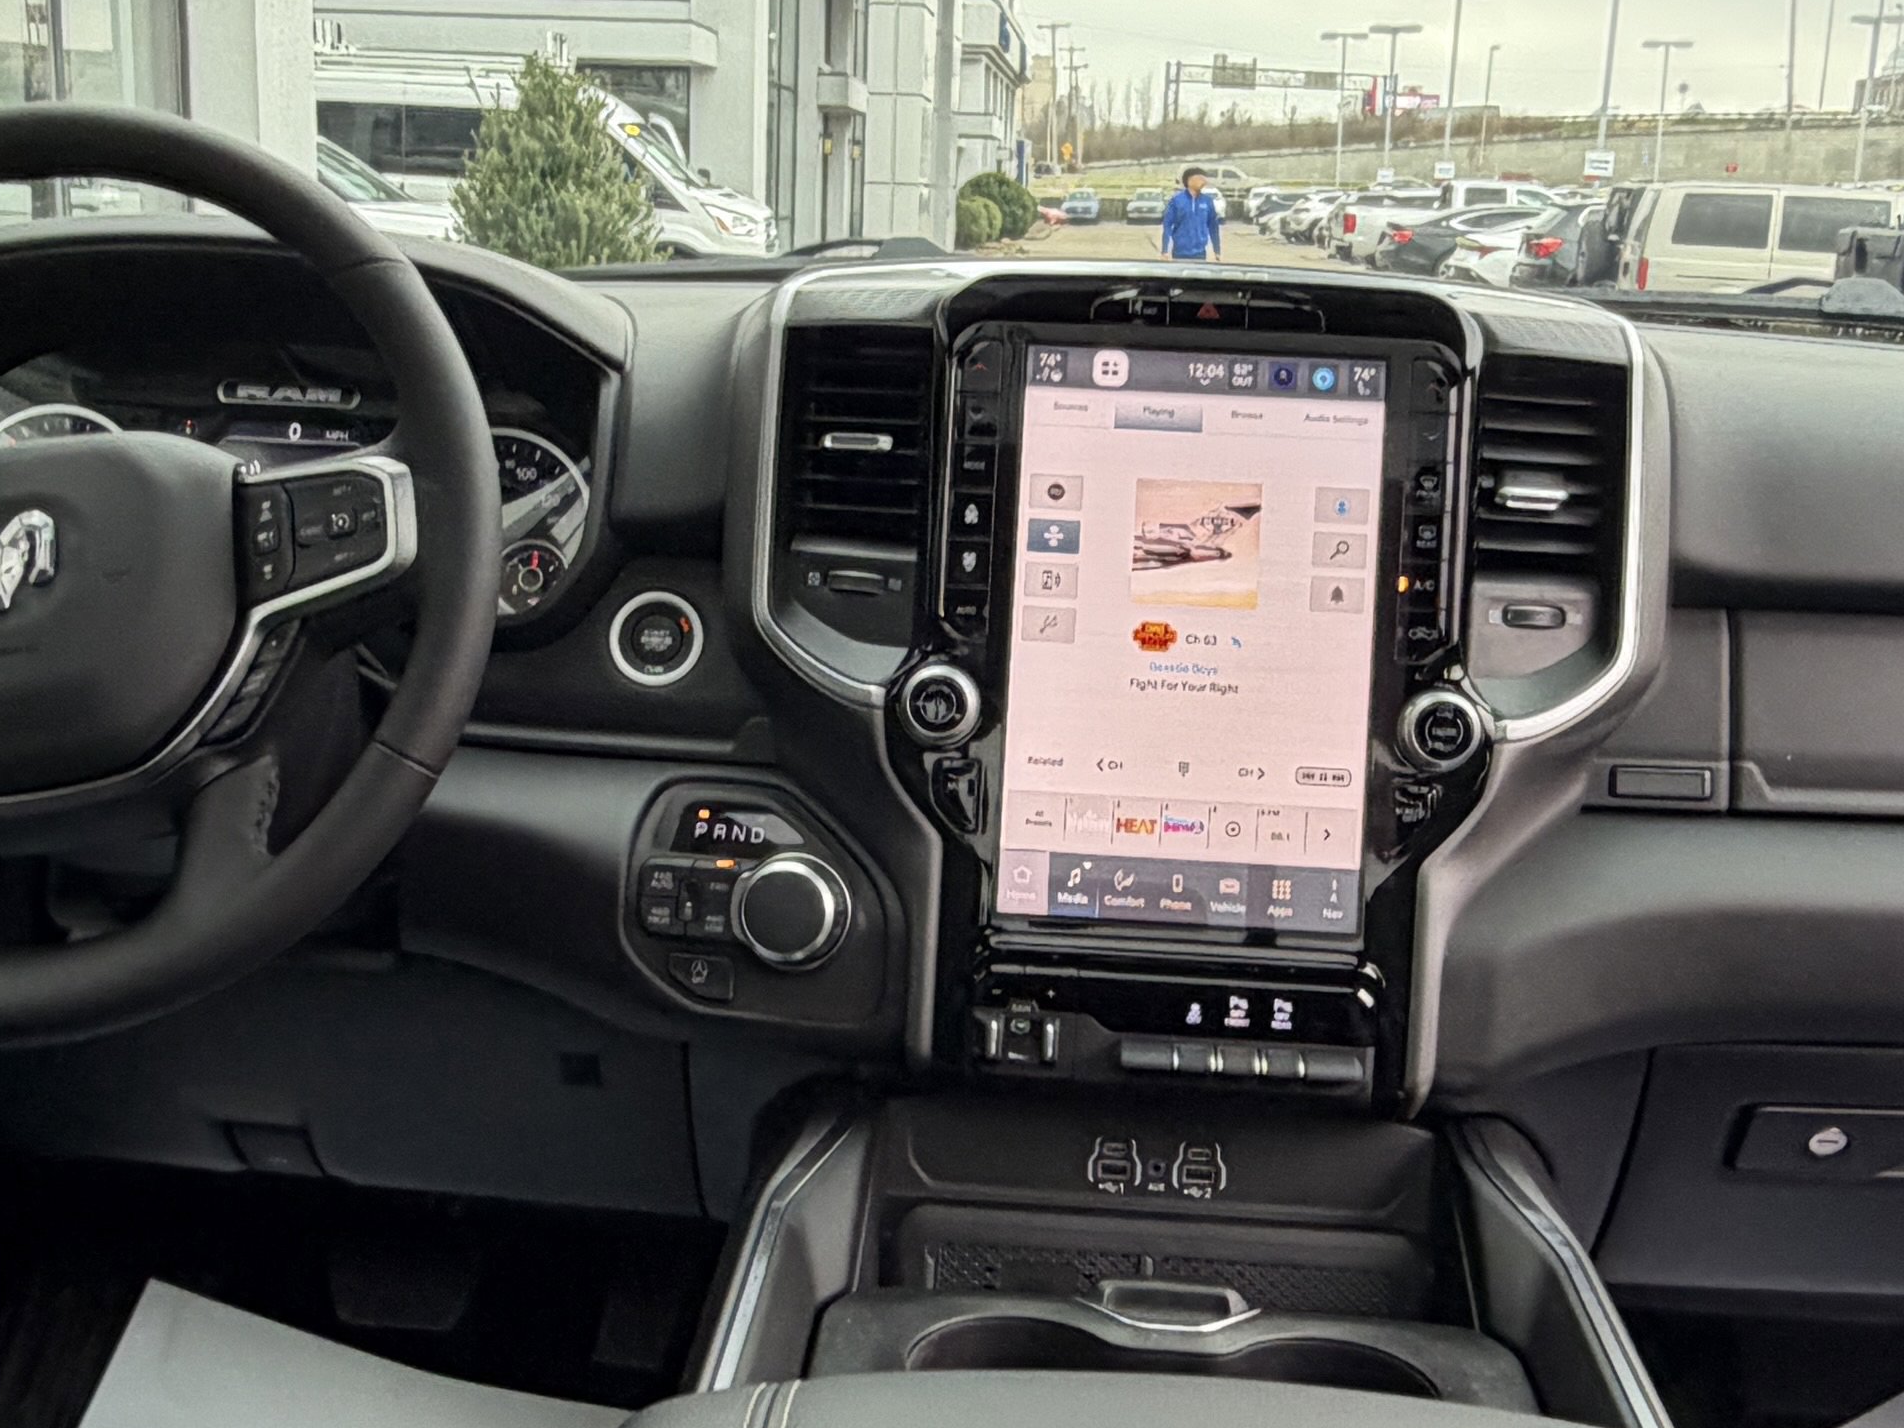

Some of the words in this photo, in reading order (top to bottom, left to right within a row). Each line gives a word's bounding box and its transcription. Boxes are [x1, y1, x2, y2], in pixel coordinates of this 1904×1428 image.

[236, 384, 343, 404] RAM
[1129, 677, 1158, 691] Fight
[1160, 679, 1179, 691] For
[1209, 682, 1239, 696] Right
[1115, 817, 1158, 834] HEAT
[1057, 891, 1089, 905] Media
